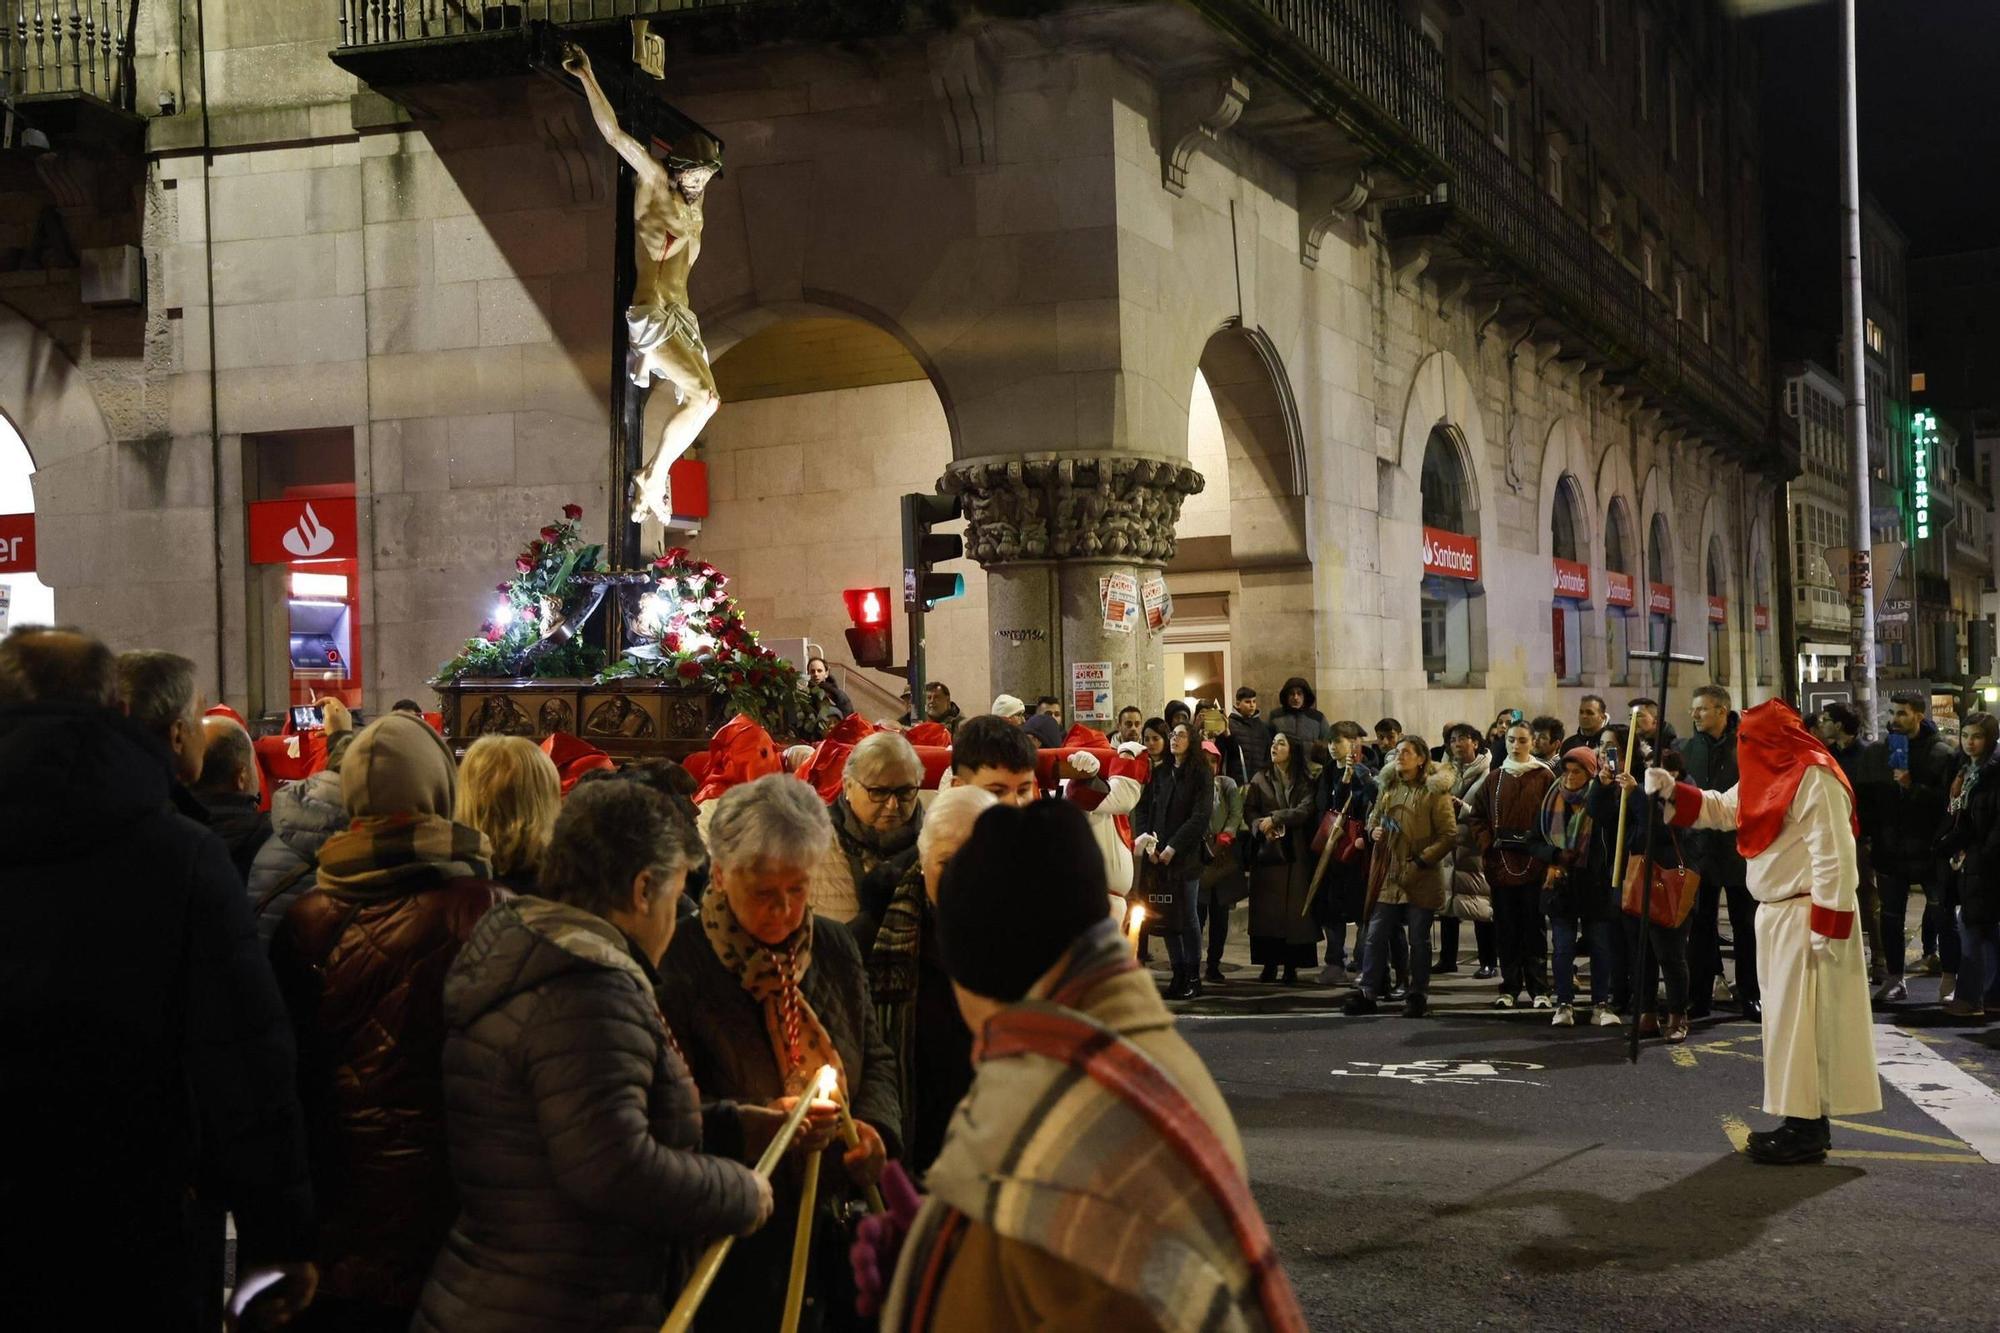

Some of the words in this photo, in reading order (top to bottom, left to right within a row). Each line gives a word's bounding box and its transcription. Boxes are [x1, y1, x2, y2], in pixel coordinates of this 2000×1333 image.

[1915, 450, 1929, 539] FORNOS
[1433, 541, 1473, 572] Santander
[1559, 570, 1586, 593] Santander
[1075, 670, 1104, 679] FOLGA
